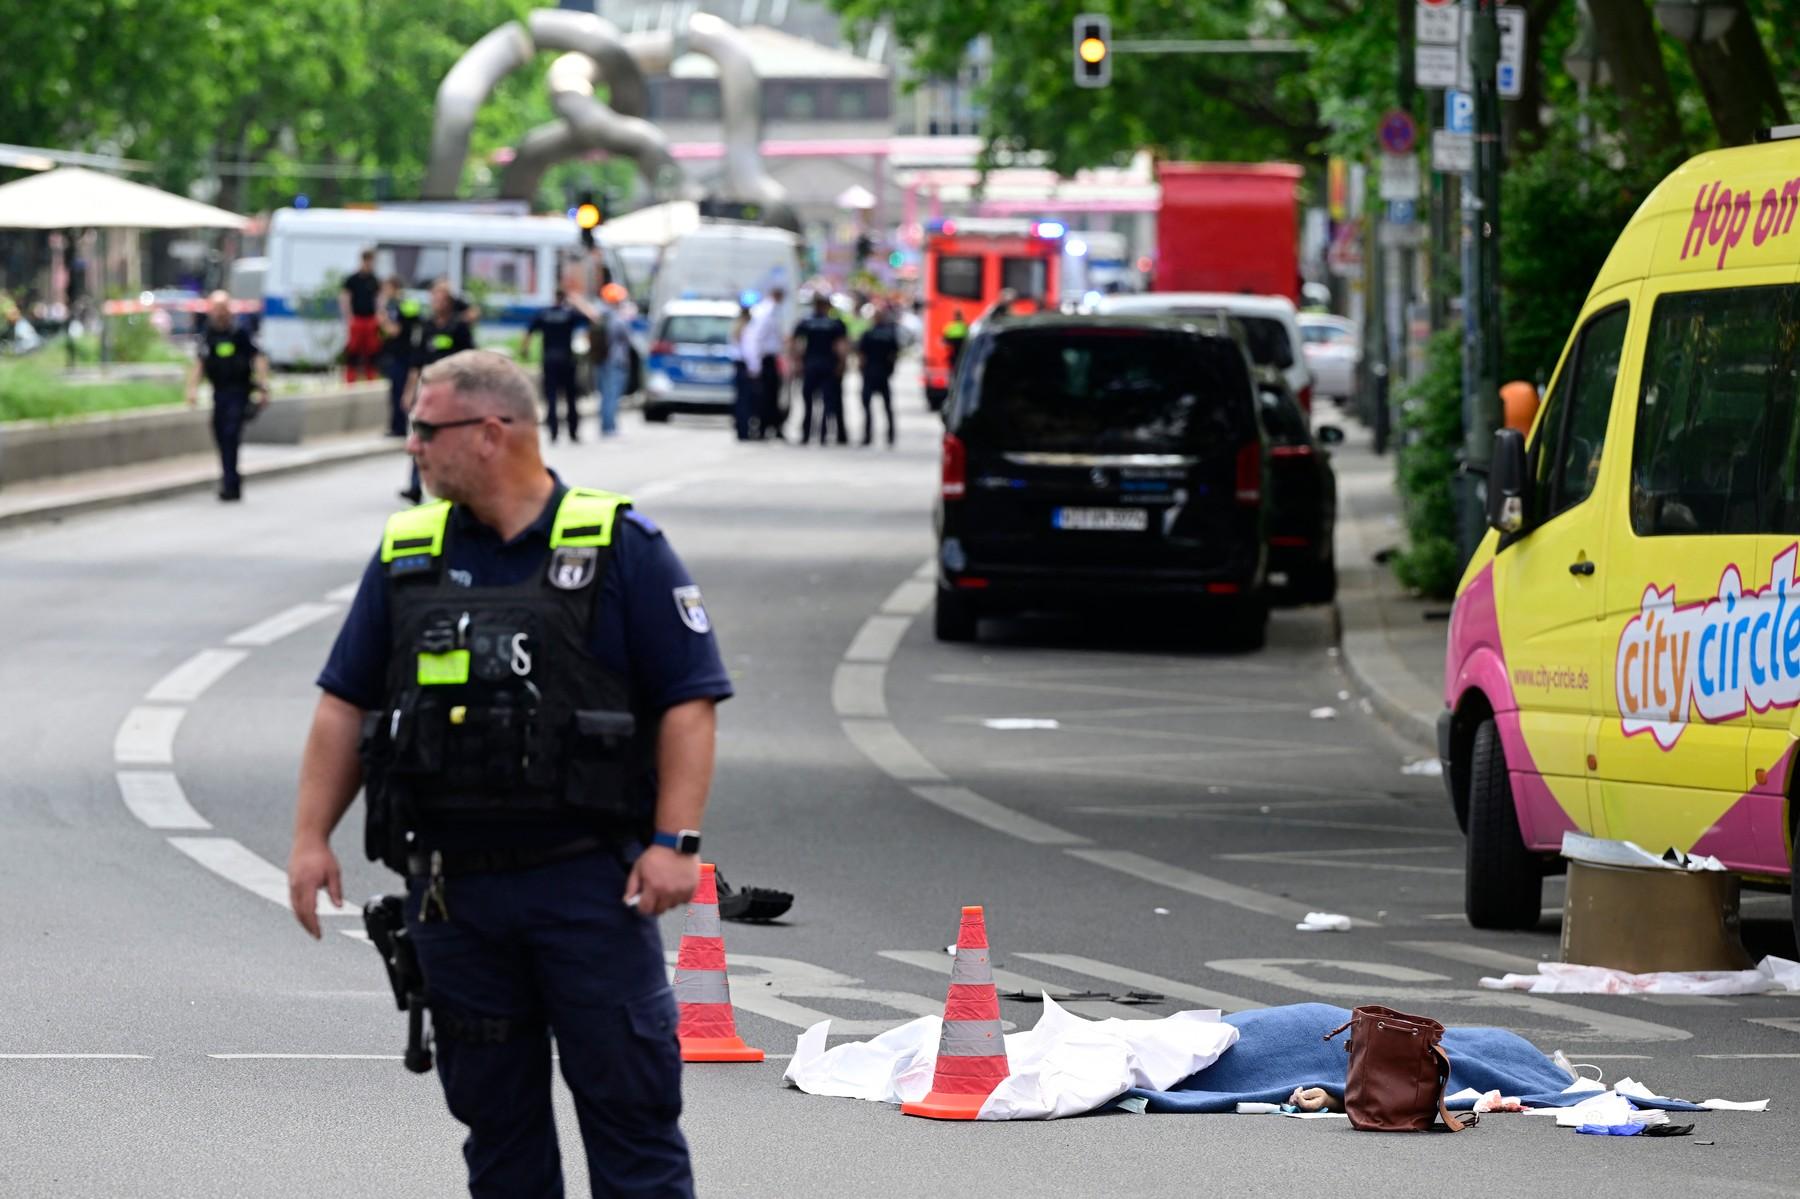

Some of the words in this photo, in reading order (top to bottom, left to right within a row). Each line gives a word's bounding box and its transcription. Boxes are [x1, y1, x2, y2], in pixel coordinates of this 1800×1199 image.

[1453, 93, 1474, 130] P
[1680, 180, 1751, 271] Hop
[1753, 177, 1800, 247] on
[1514, 663, 1589, 694] www.city-circle.de
[1623, 610, 1690, 723] city
[1698, 577, 1800, 697] circle
